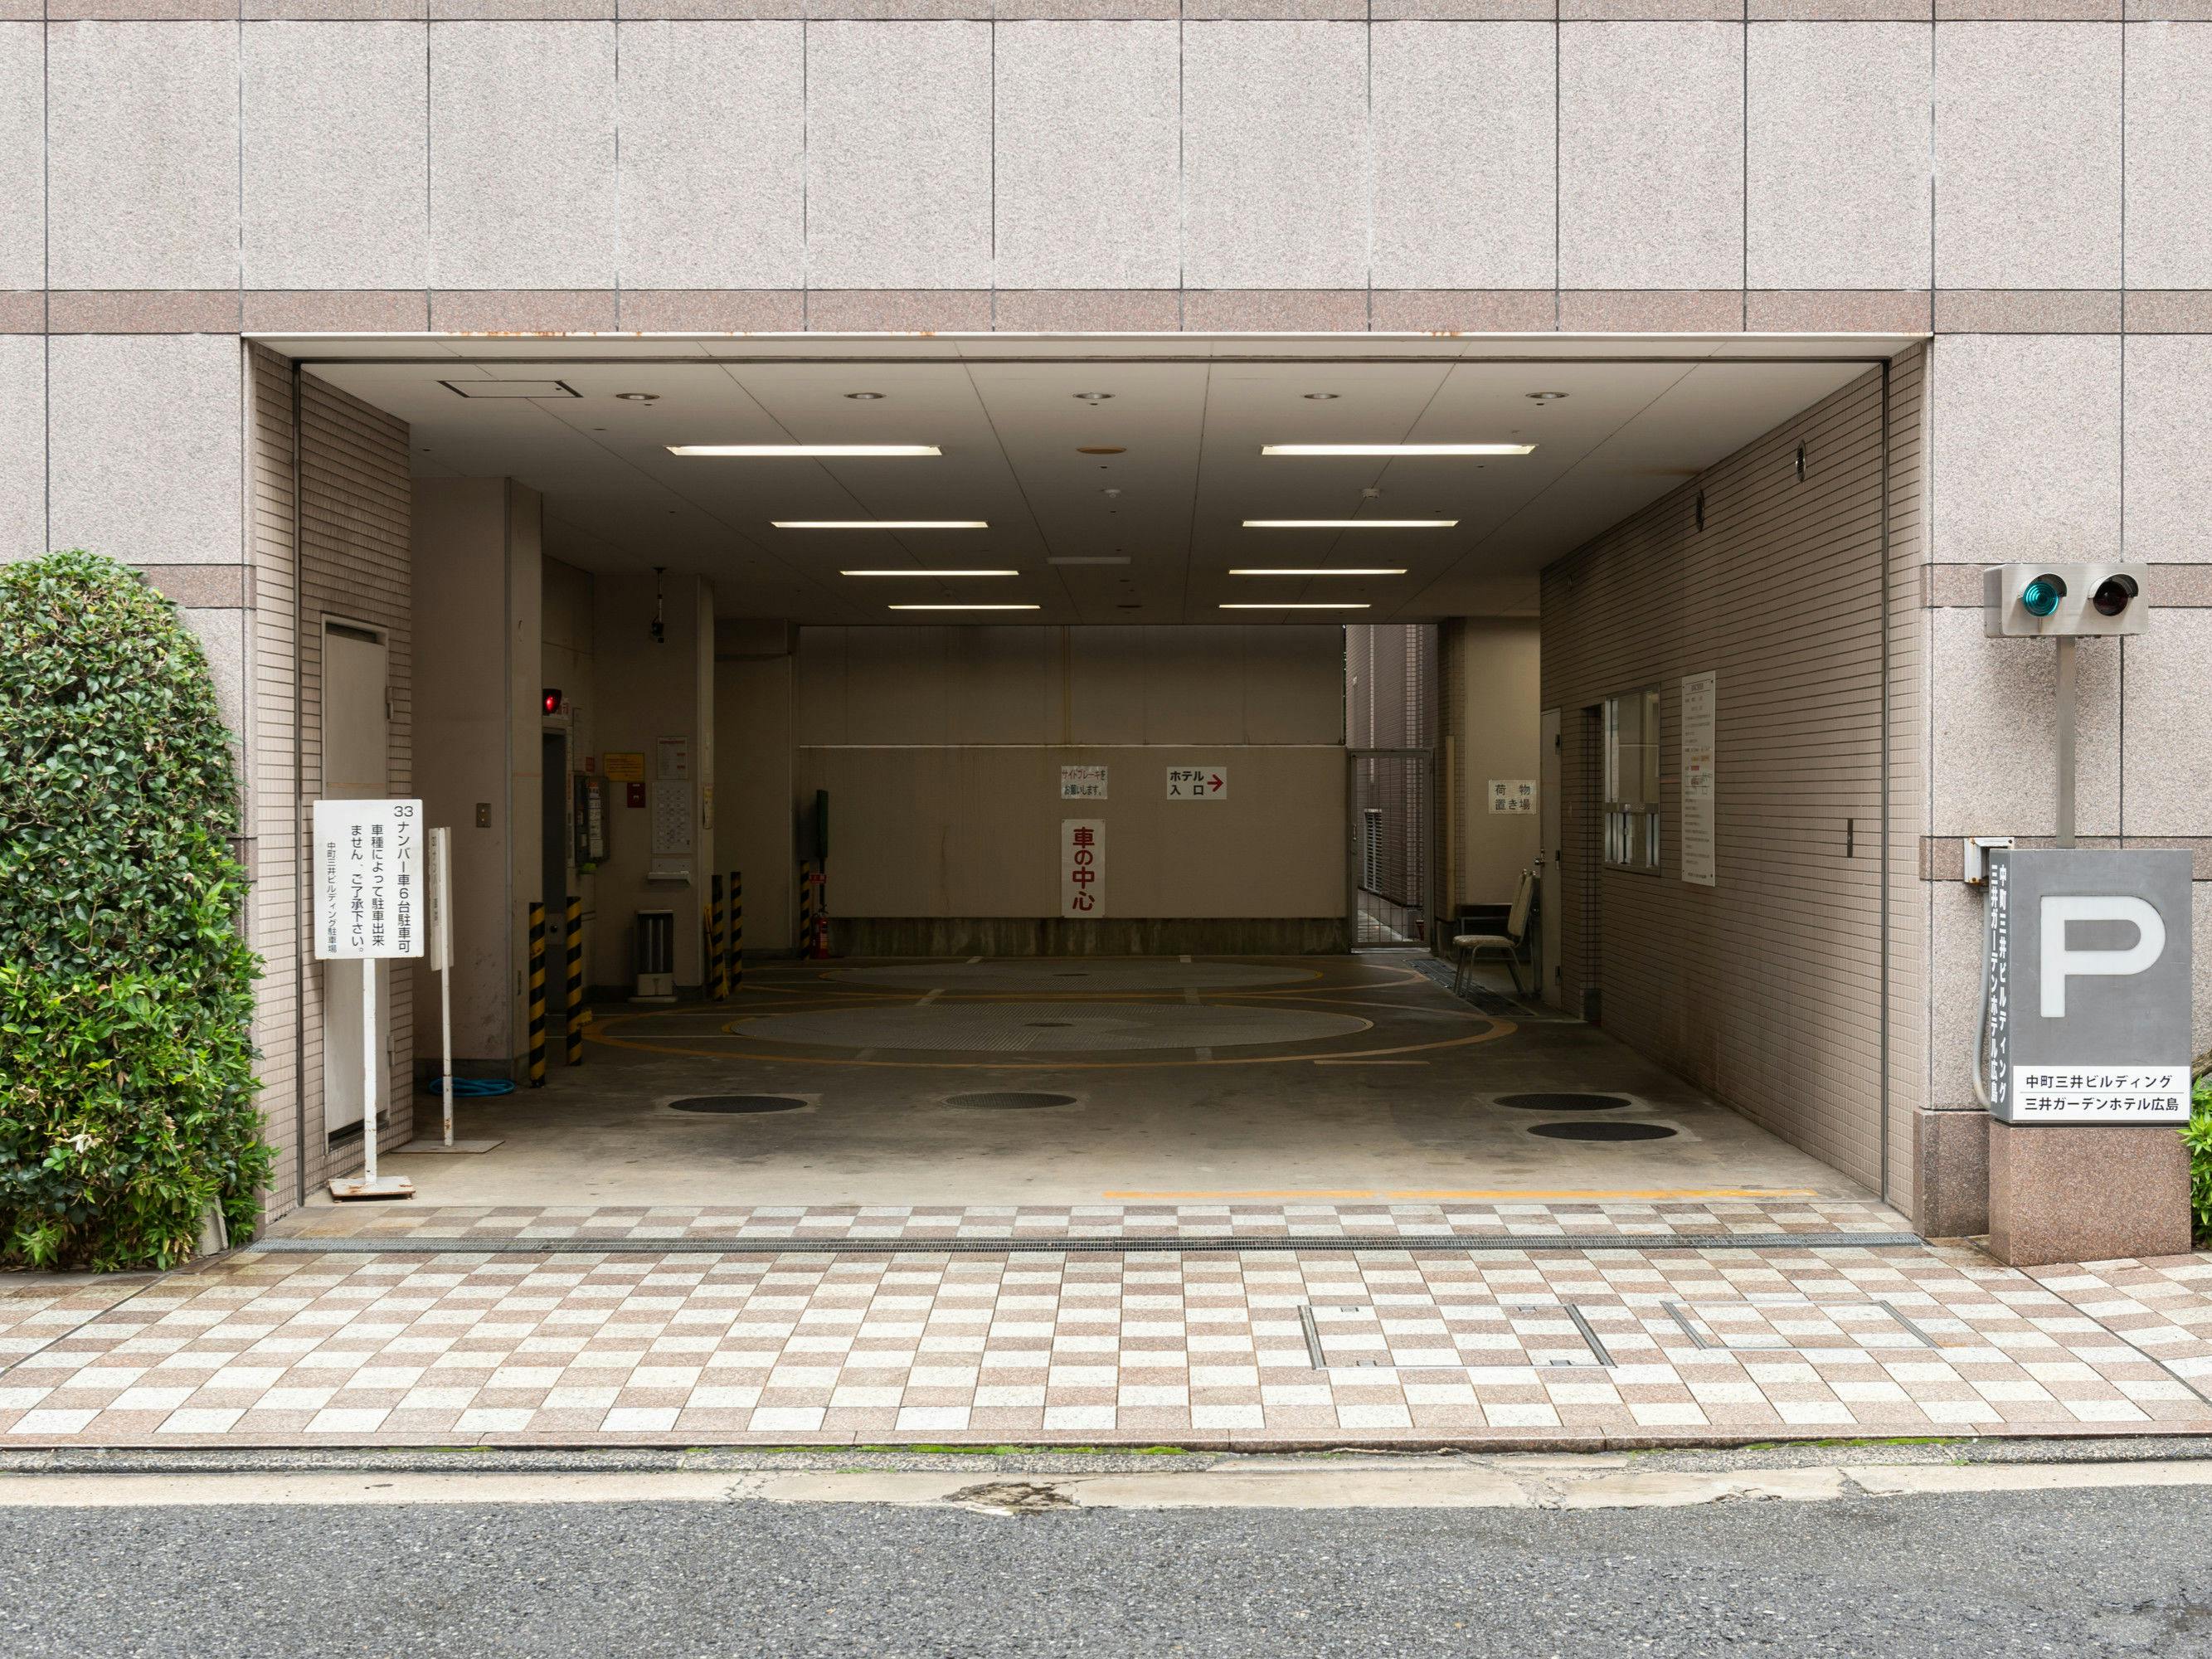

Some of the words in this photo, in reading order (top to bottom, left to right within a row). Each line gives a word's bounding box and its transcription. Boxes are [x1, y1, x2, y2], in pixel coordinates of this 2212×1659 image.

[1169, 771, 1204, 781] ホテル
[1169, 785, 1204, 796] 入口
[1495, 784, 1531, 796] 荷物
[1495, 798, 1532, 810] 置き場
[1072, 826, 1095, 912] 車の中心
[371, 824, 385, 946] 車種によって駐車出来
[2040, 896, 2166, 1018] P
[2025, 1074, 2173, 1089] 中町三井ビルディング
[2025, 1097, 2179, 1112] 三井ガーデンホテル広島
